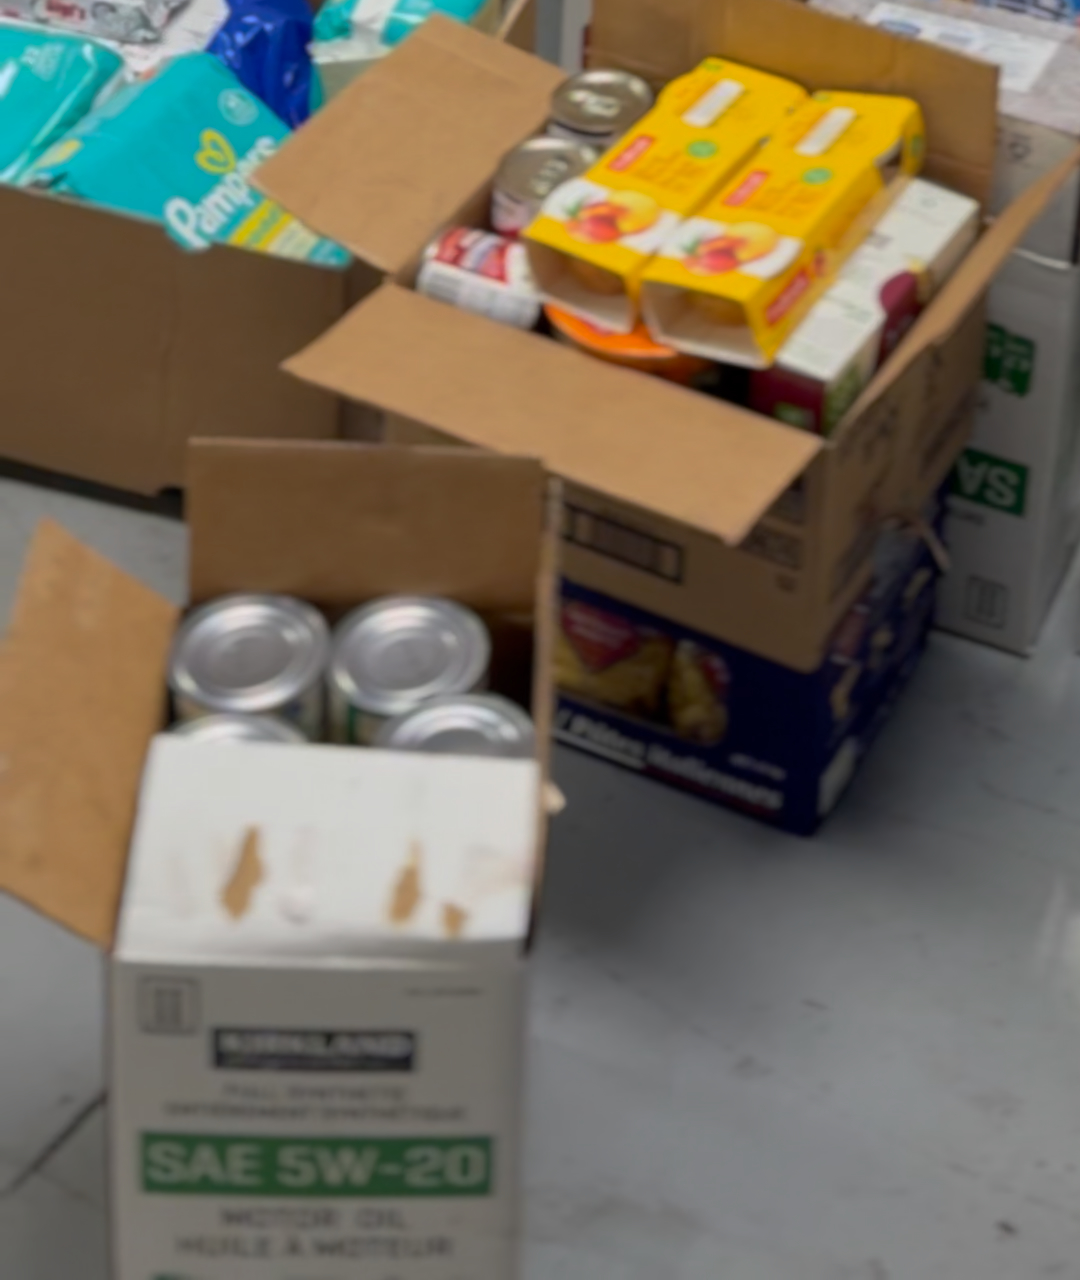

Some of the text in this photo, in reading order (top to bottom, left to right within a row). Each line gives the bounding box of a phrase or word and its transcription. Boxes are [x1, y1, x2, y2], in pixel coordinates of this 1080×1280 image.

[956, 453, 1021, 509] SA
[146, 1141, 488, 1188] SAE 5W-20
